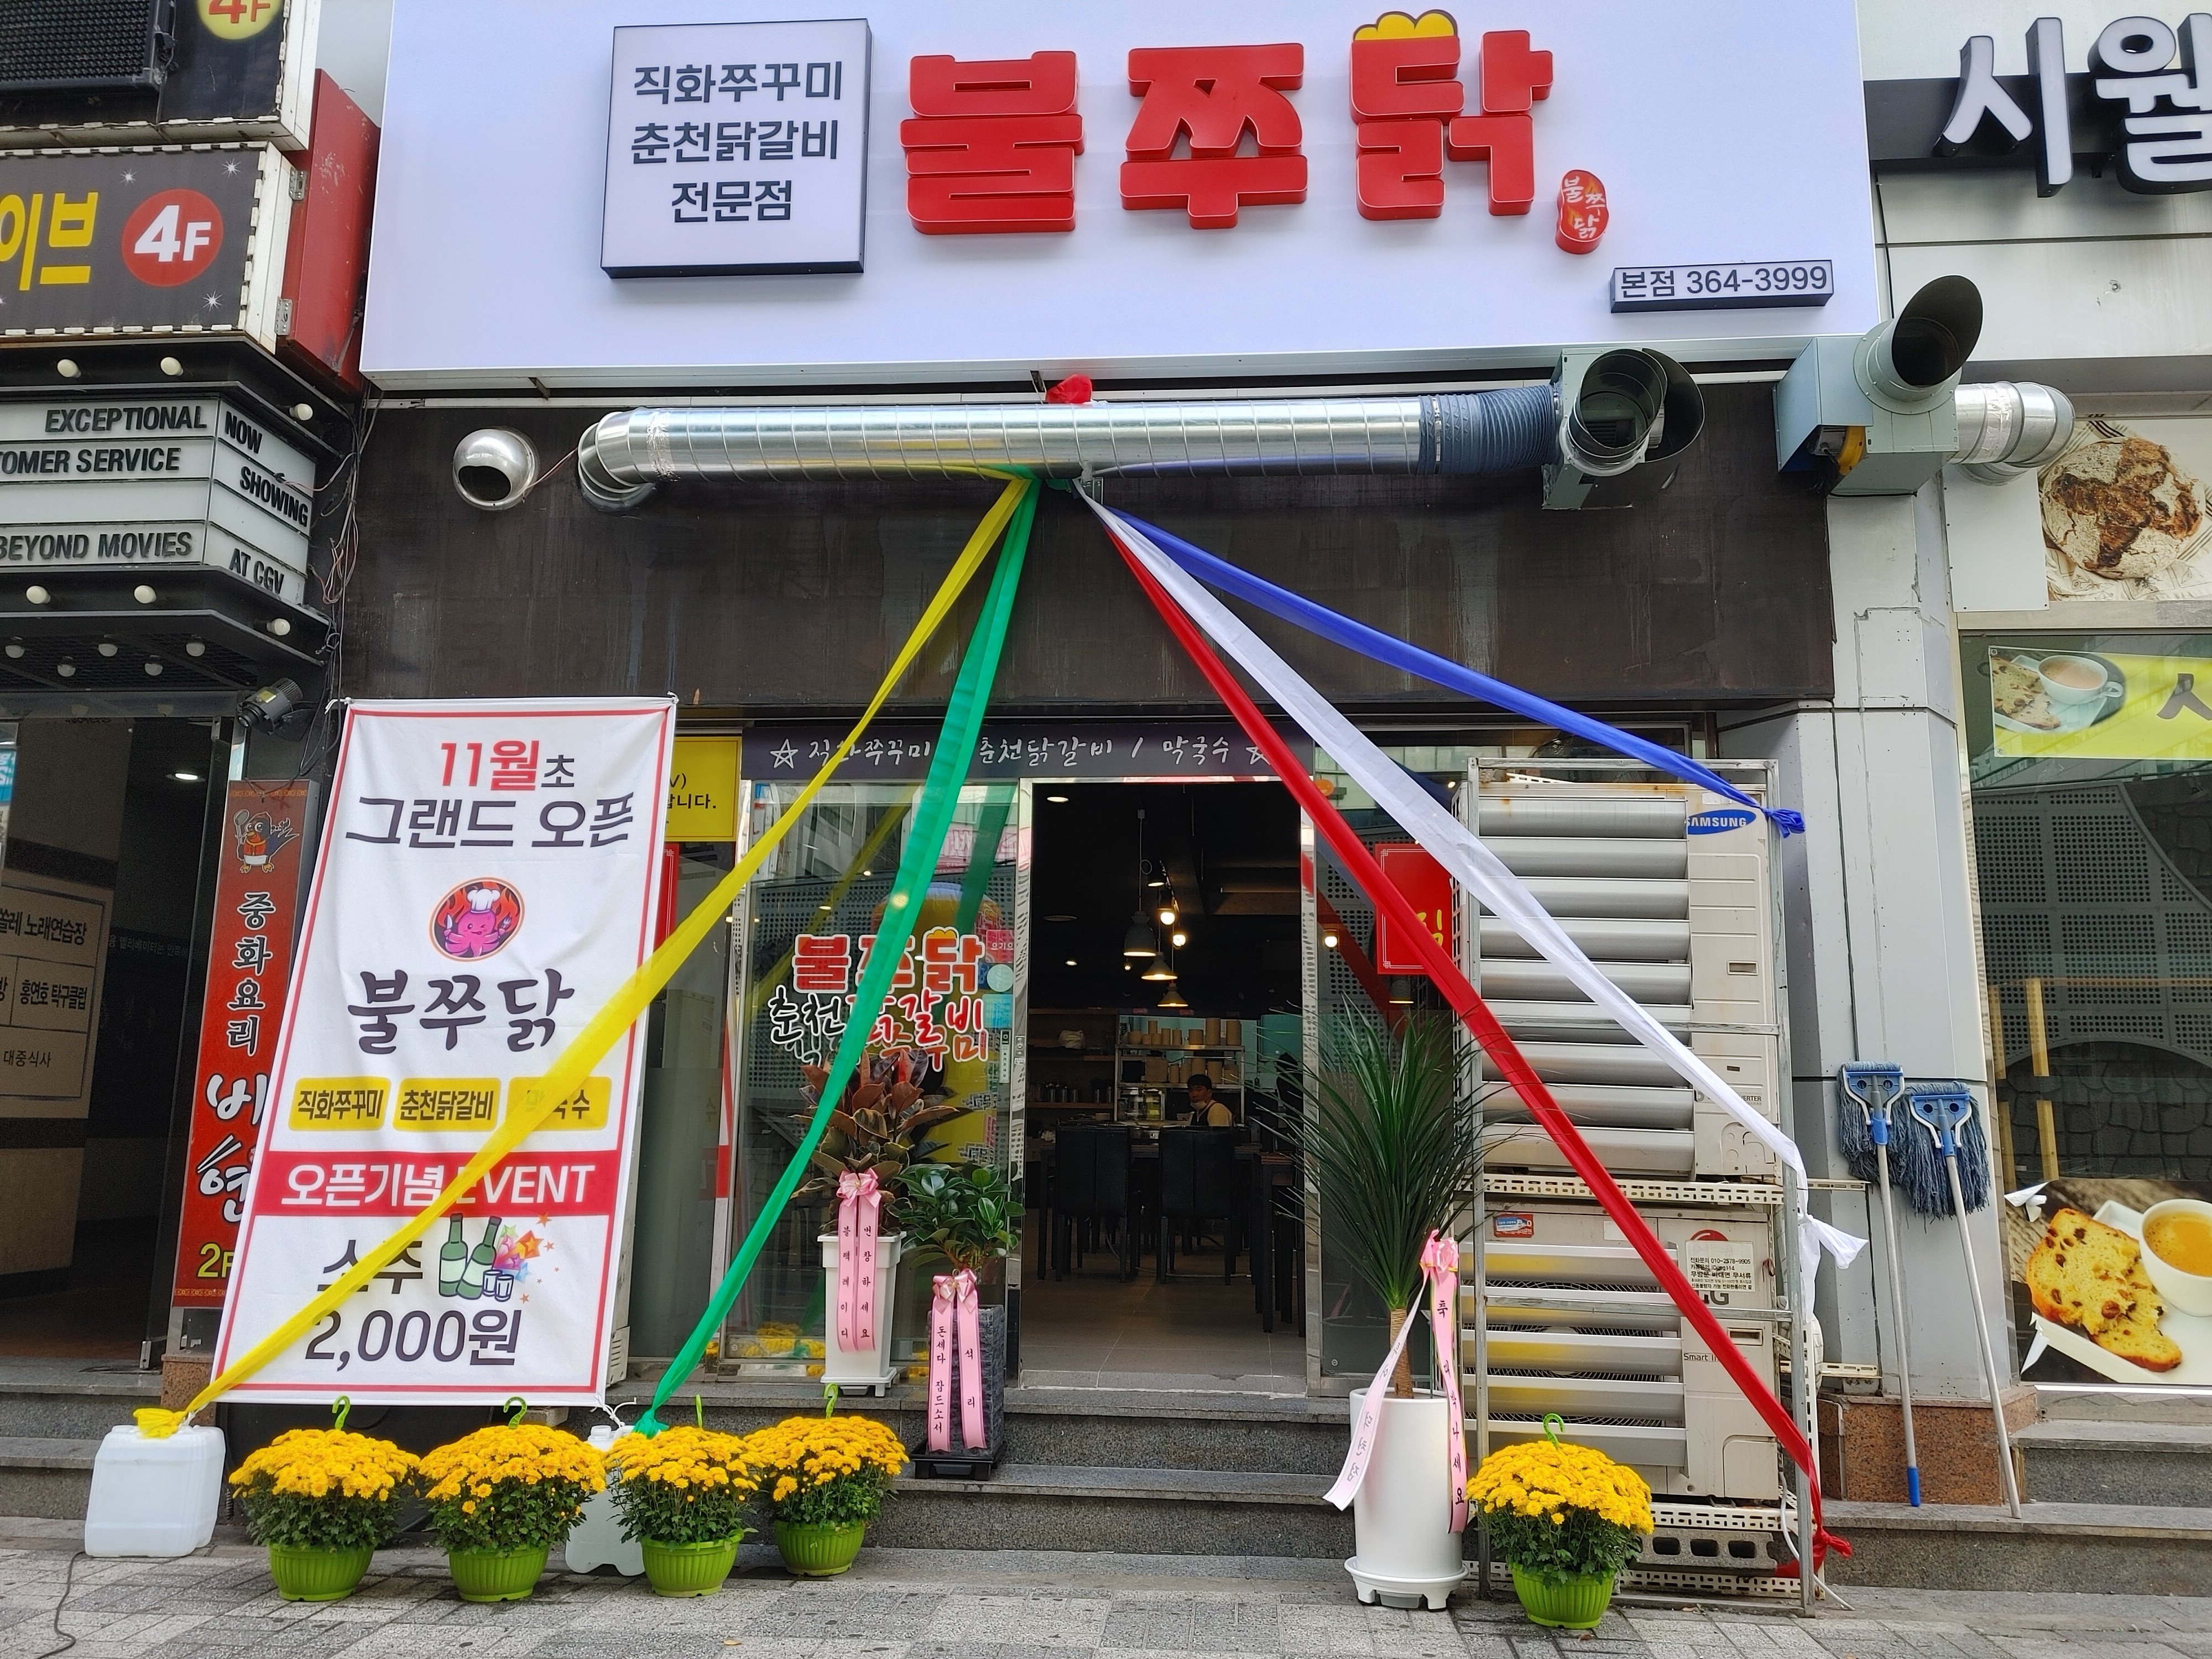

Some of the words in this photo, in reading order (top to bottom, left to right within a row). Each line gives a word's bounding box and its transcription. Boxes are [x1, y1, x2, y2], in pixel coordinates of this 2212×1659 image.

[634, 61, 842, 105] 직화쭈꾸미
[1933, 13, 2212, 197] 시월
[631, 119, 838, 165] 춘천닭갈비
[900, 10, 1554, 235] 불쭈닭
[671, 180, 792, 223] 전문점
[134, 205, 212, 262] 4F
[1621, 270, 1675, 299] 본점
[1687, 266, 1827, 294] 364-3999
[45, 405, 207, 433] EXCEPTIONAL
[225, 411, 263, 455] NOW
[0, 450, 70, 474] OMER
[76, 447, 181, 473] SERVICE
[239, 466, 309, 528] SHOWING
[0, 534, 90, 561] BEYOND
[97, 531, 192, 557] MOVIES
[229, 547, 252, 578] AT
[253, 560, 285, 595] CGV
[979, 736, 1112, 767] 춘천닭갈비
[1162, 735, 1229, 765] 막국수
[346, 796, 517, 848] 그랜드
[531, 791, 634, 848] 오픈
[24, 914, 87, 946] 노래연습장
[990, 942, 1014, 951] 요기요
[226, 891, 276, 1057] 중화요리
[51, 984, 88, 1010] 탁구클럽
[347, 968, 575, 1055] 불쭈닭
[3, 1049, 52, 1068] 대중식사
[297, 1089, 384, 1120] 직화쭈꾸미
[400, 1089, 495, 1121] 춘천닭갈비
[280, 1163, 445, 1207] 오픈기념
[317, 1239, 424, 1295] 소주
[860, 1225, 872, 1339] 번창하세요
[305, 1309, 522, 1372] 2,000원
[936, 1326, 947, 1365] 돈세다
[1683, 1353, 1708, 1361] Smart
[933, 1380, 945, 1434] 잠드소서
[1437, 1300, 1448, 1318] 축
[1443, 1359, 1465, 1505] 대박나세요
